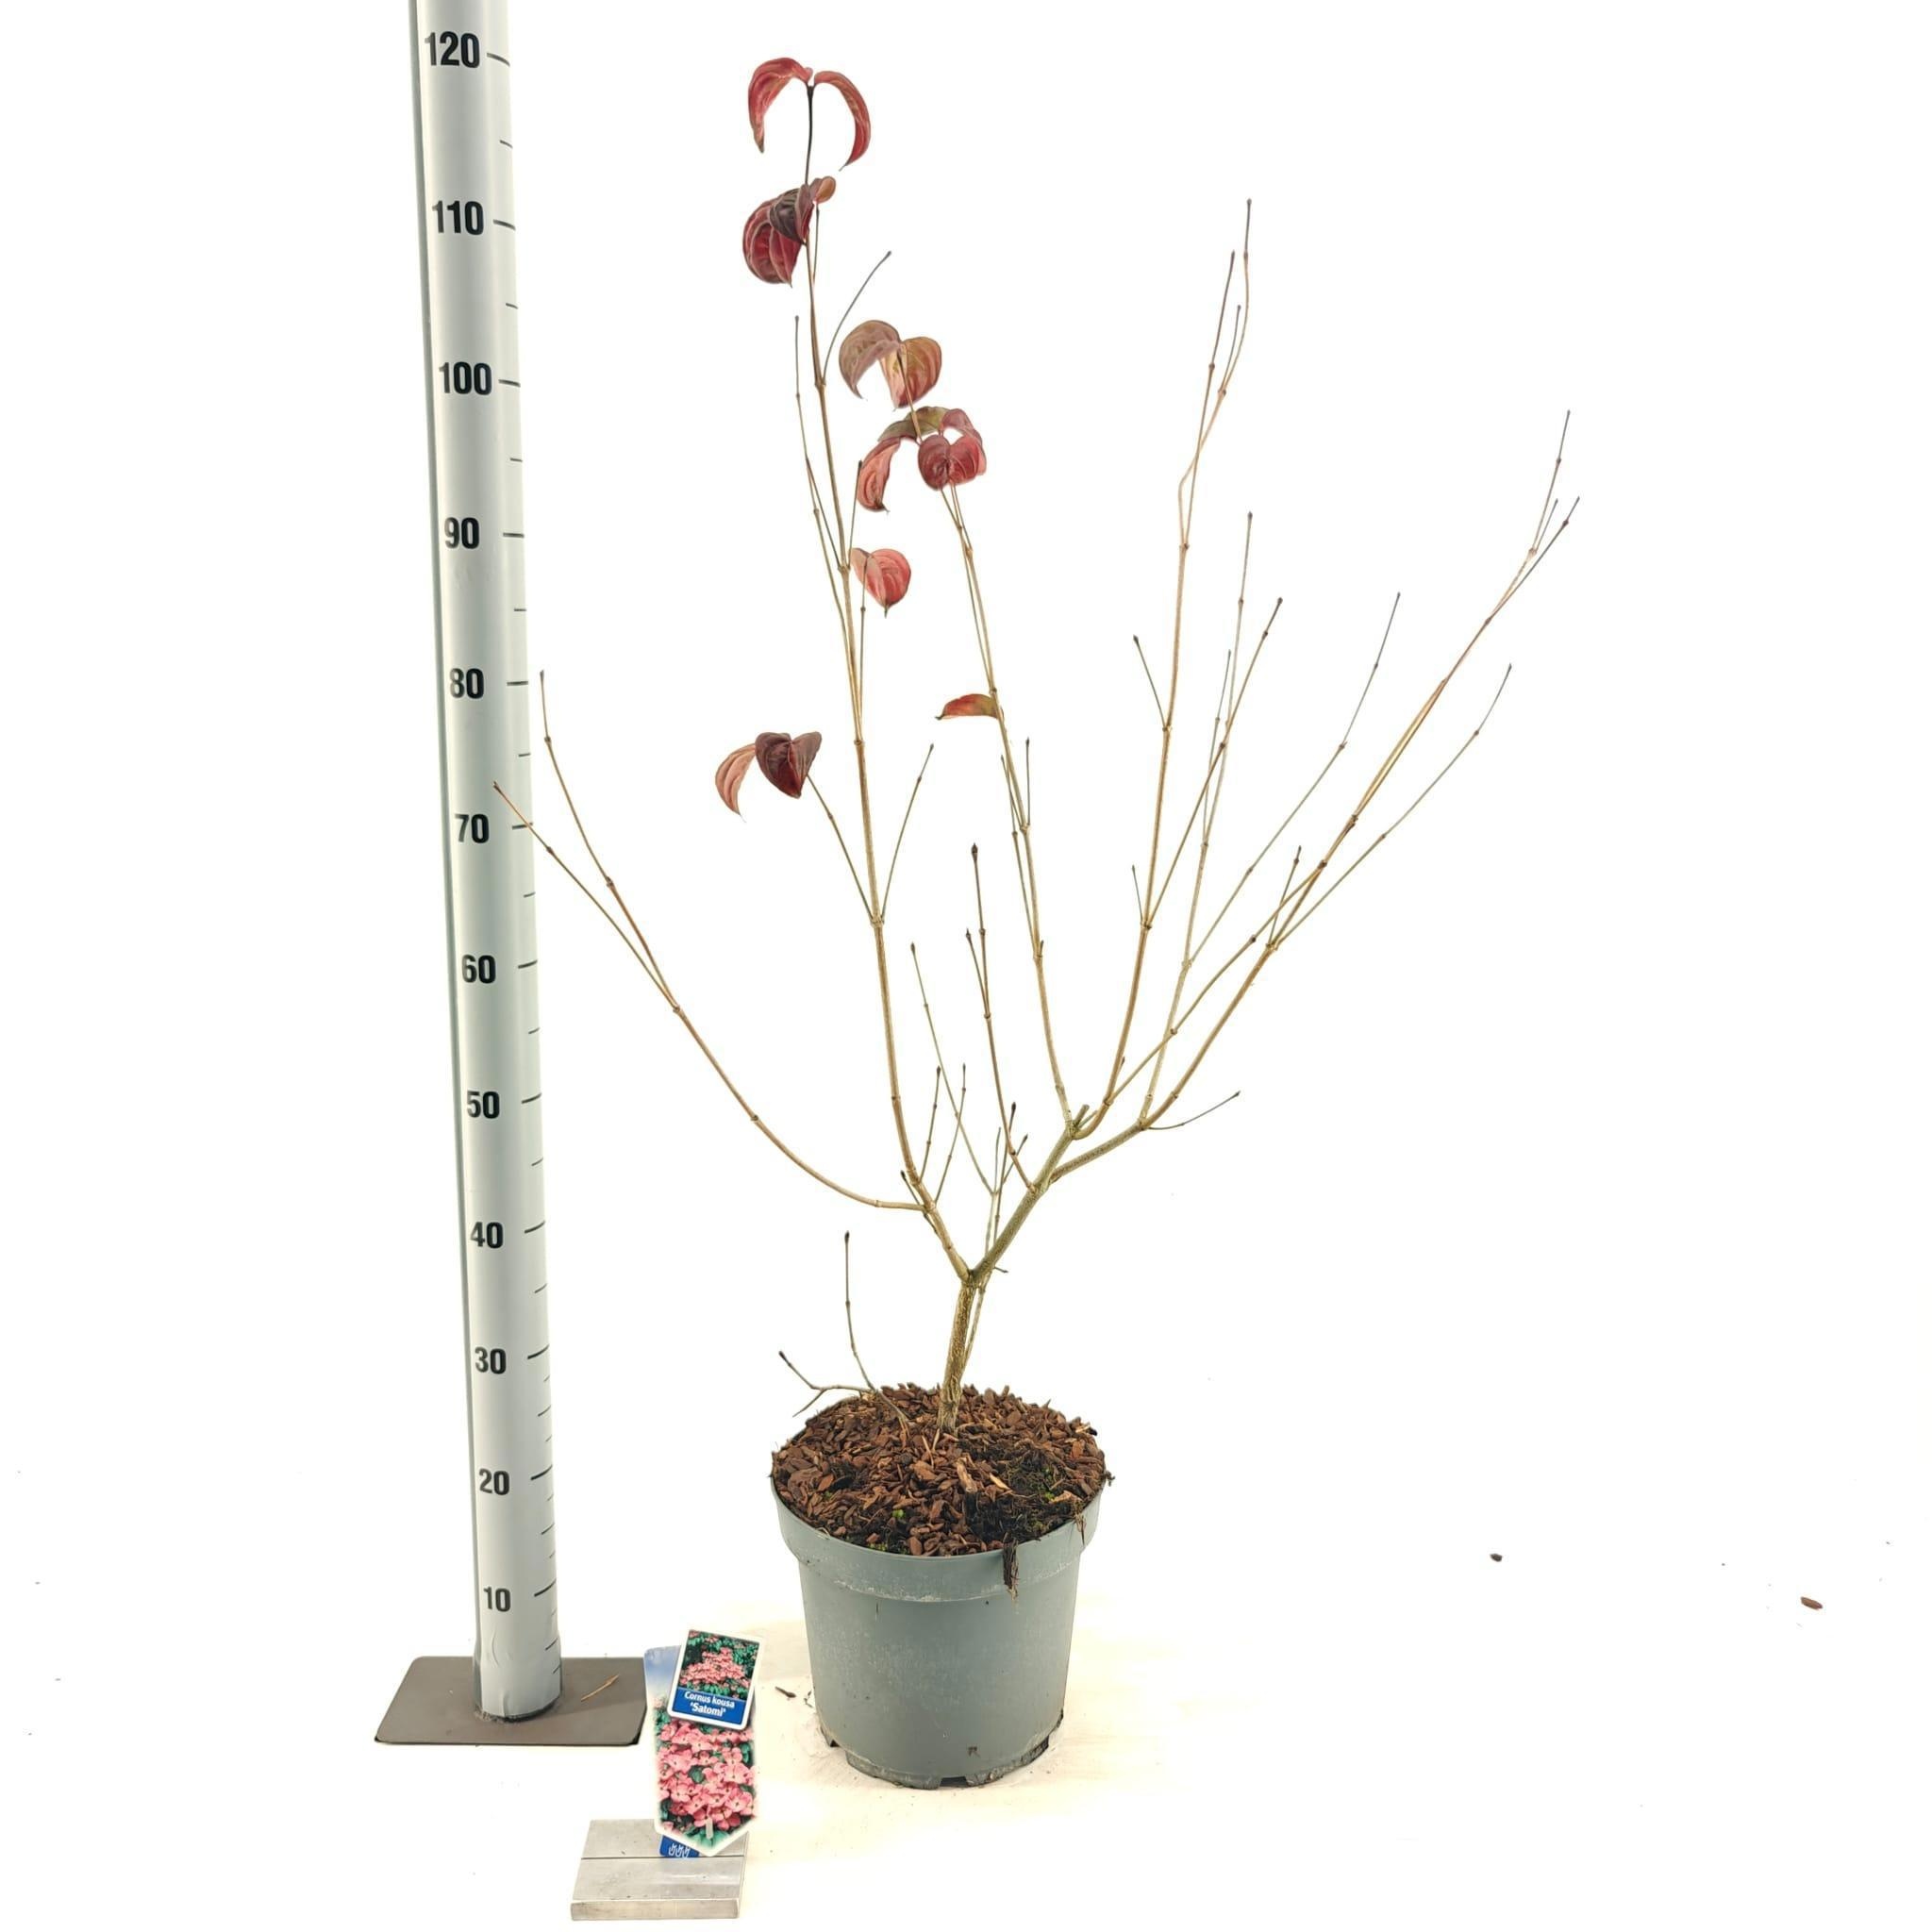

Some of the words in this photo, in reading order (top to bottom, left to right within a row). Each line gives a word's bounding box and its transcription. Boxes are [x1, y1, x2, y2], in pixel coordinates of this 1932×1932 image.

[424, 31, 480, 69] 120
[431, 201, 484, 236] 110
[438, 362, 492, 395] 100
[444, 517, 480, 550] 90
[449, 668, 485, 700] 80
[454, 814, 490, 844] 70
[460, 955, 496, 985] 60
[466, 1091, 500, 1120] 50
[470, 1222, 504, 1249] 40
[474, 1347, 507, 1374] 30
[478, 1469, 510, 1496] 20
[483, 1587, 511, 1612] 10
[684, 1690, 711, 1704] Cornus
[712, 1696, 735, 1708] kousa
